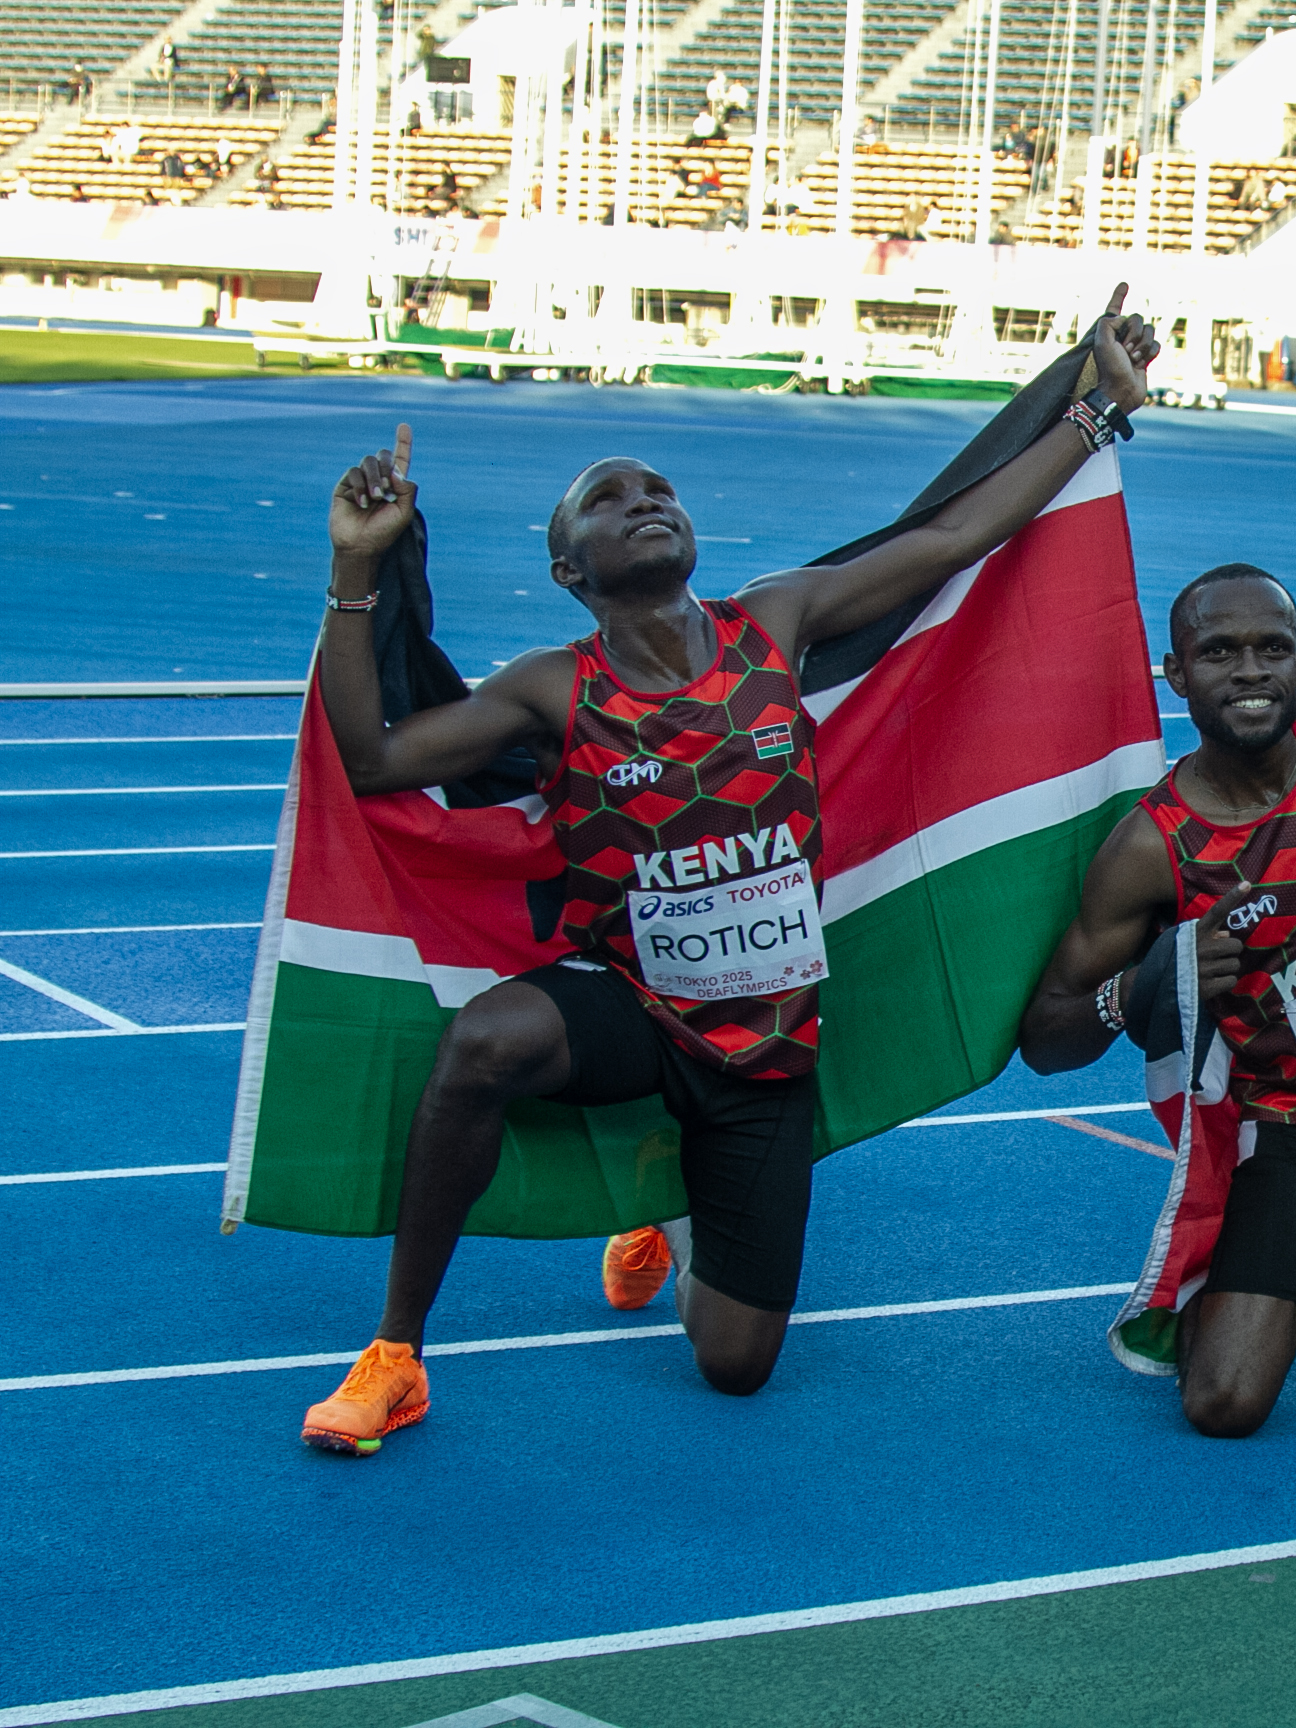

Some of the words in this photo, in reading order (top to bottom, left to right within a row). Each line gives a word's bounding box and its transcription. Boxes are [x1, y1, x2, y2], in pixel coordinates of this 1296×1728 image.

[633, 822, 800, 889] KENYA
[726, 872, 805, 904] TOYOTA
[649, 908, 809, 963] ROTICH
[675, 973, 719, 988] TOKYO
[721, 970, 753, 984] 2025
[697, 976, 788, 999] DEAFLYMPICS
